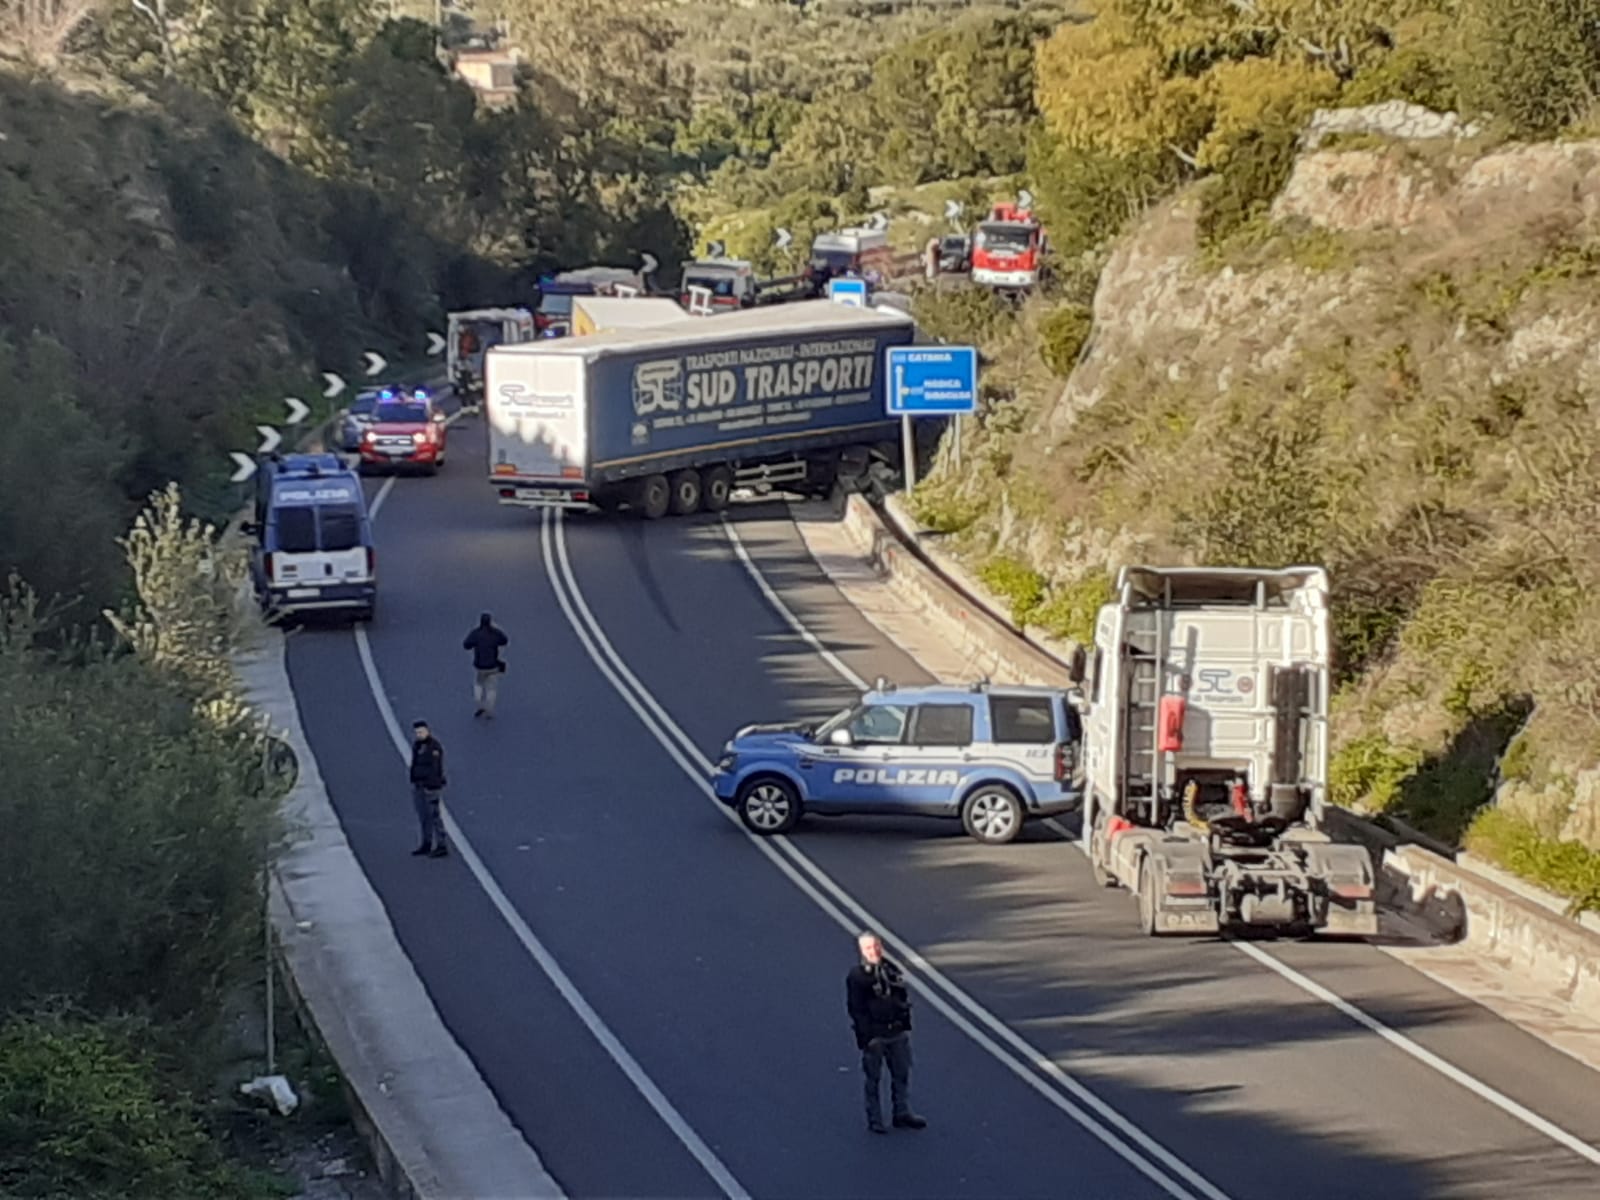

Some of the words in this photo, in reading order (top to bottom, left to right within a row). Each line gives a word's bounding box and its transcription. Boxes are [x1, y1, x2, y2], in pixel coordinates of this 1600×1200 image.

[686, 370, 736, 409] SUD
[745, 355, 875, 401] TRASPORTI
[833, 767, 960, 785] POLIZIA
